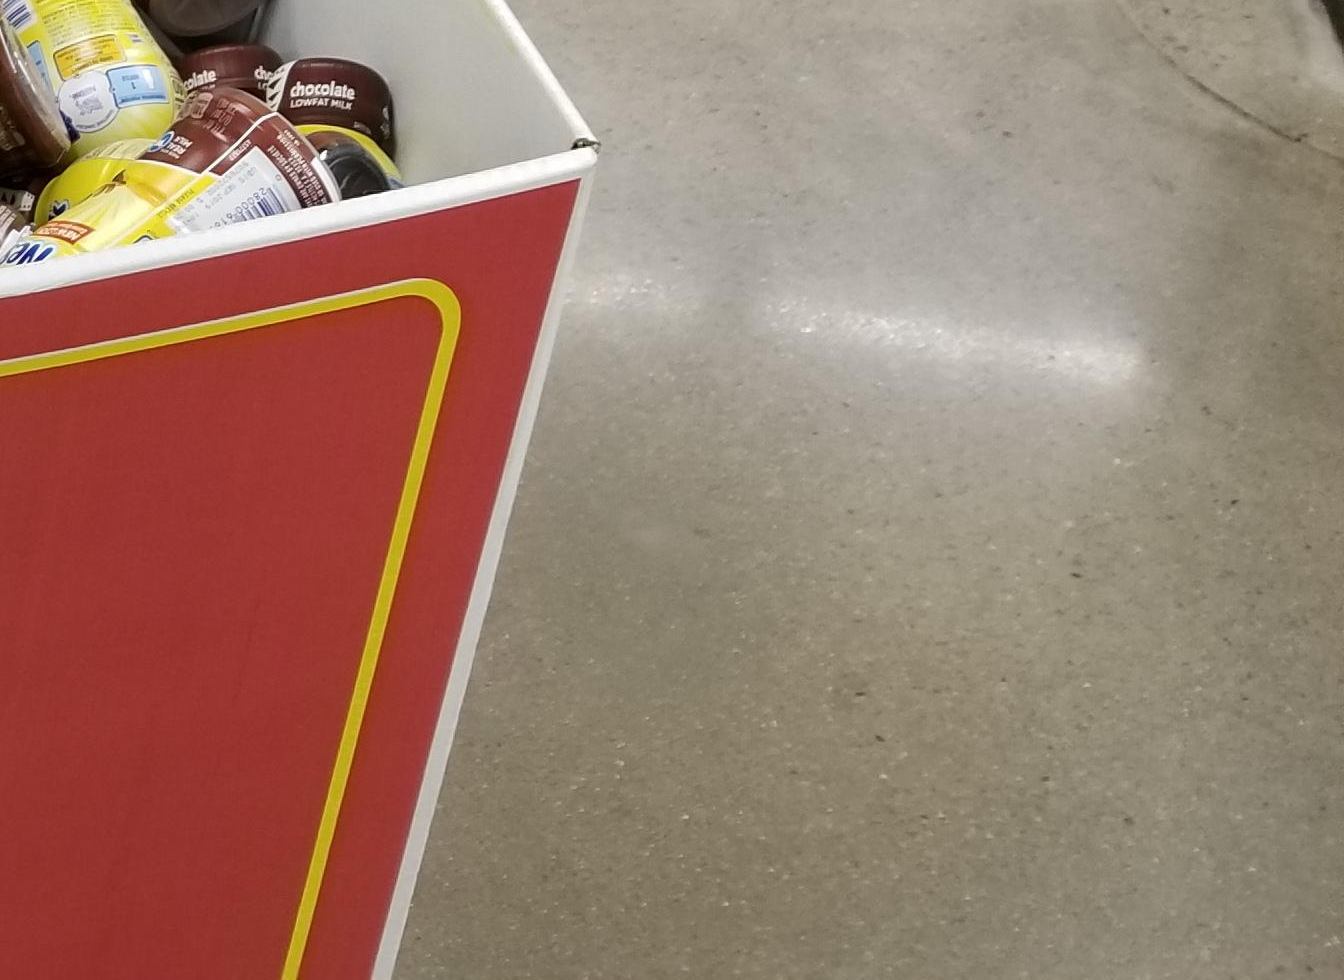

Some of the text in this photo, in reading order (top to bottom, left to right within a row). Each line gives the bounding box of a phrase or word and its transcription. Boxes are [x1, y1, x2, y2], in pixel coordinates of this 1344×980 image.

[290, 80, 356, 100] chocolate
[290, 98, 353, 110] LOWFAT MILK
